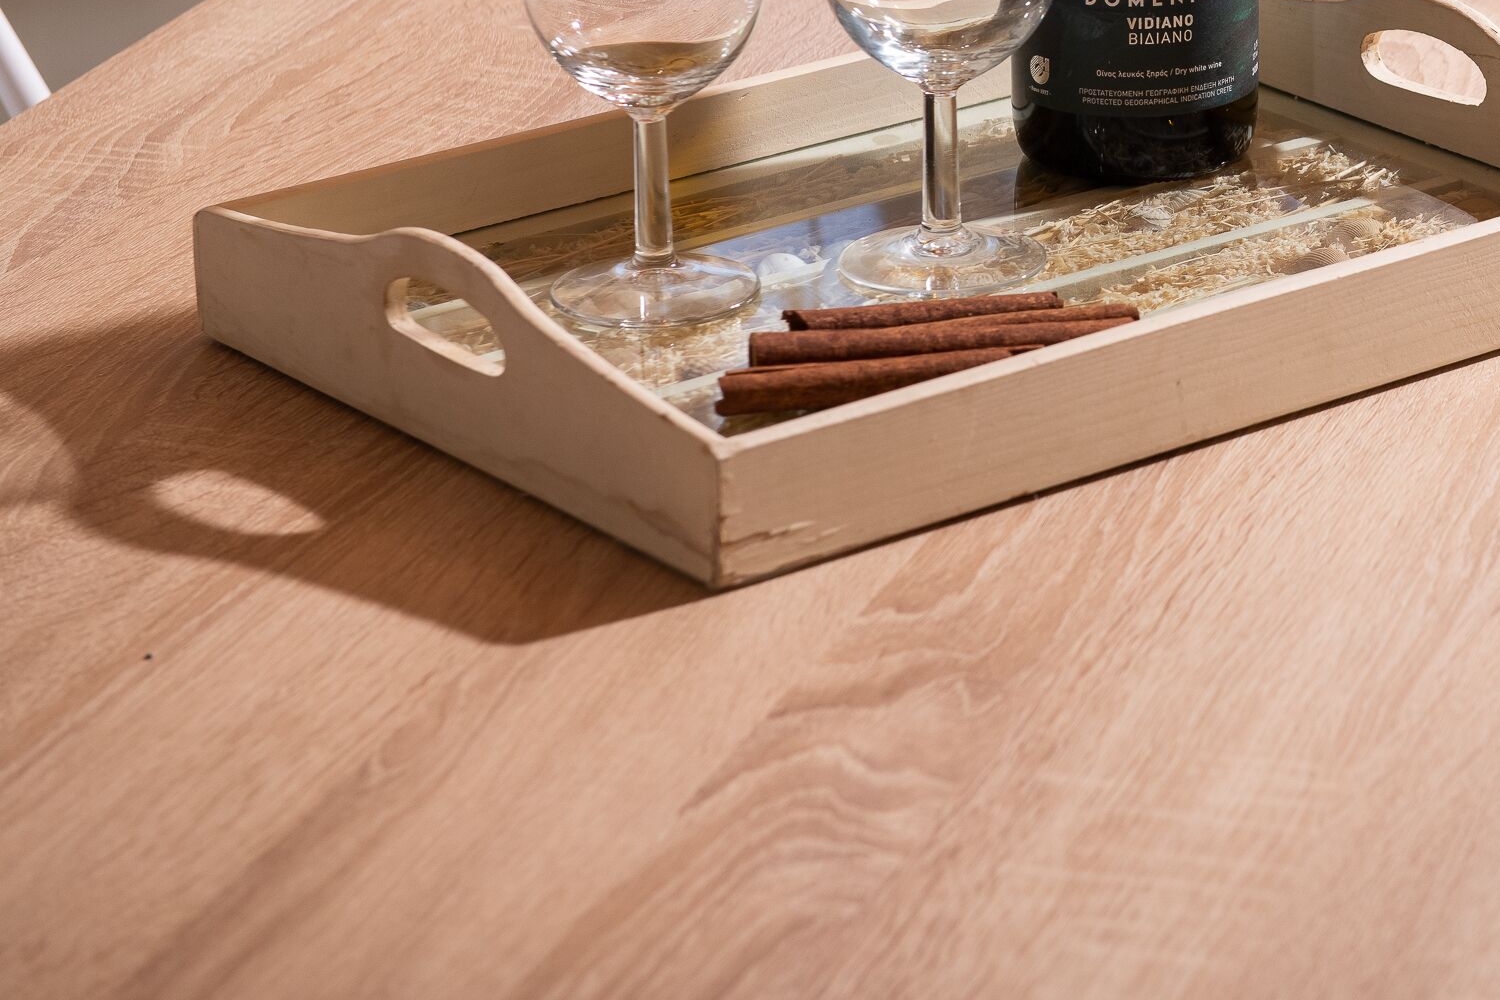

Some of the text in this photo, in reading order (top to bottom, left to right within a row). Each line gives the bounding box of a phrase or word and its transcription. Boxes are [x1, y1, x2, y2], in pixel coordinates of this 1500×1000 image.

[1126, 13, 1194, 30] VIDIANO
[1128, 29, 1193, 45] ΒΙΔΙΑΝΟ
[1096, 69, 1116, 79] Οίνος
[1118, 70, 1145, 79] λευκός
[1146, 69, 1168, 79] ξηρός
[1175, 67, 1188, 76] Dry
[1189, 64, 1207, 73] white
[1207, 61, 1222, 70] wine
[1078, 87, 1144, 97] ΠΡΟΣΤΑΤΕΥΟΜΕΝΗ
[1145, 86, 1189, 97] ΓΕΩΓΡΑΦΙΚΗ
[1217, 75, 1235, 87] ΚΡΗΤΗ
[1082, 84, 1233, 106] PROTECTED GEOGRAPHICAL INDICATION CRETE
